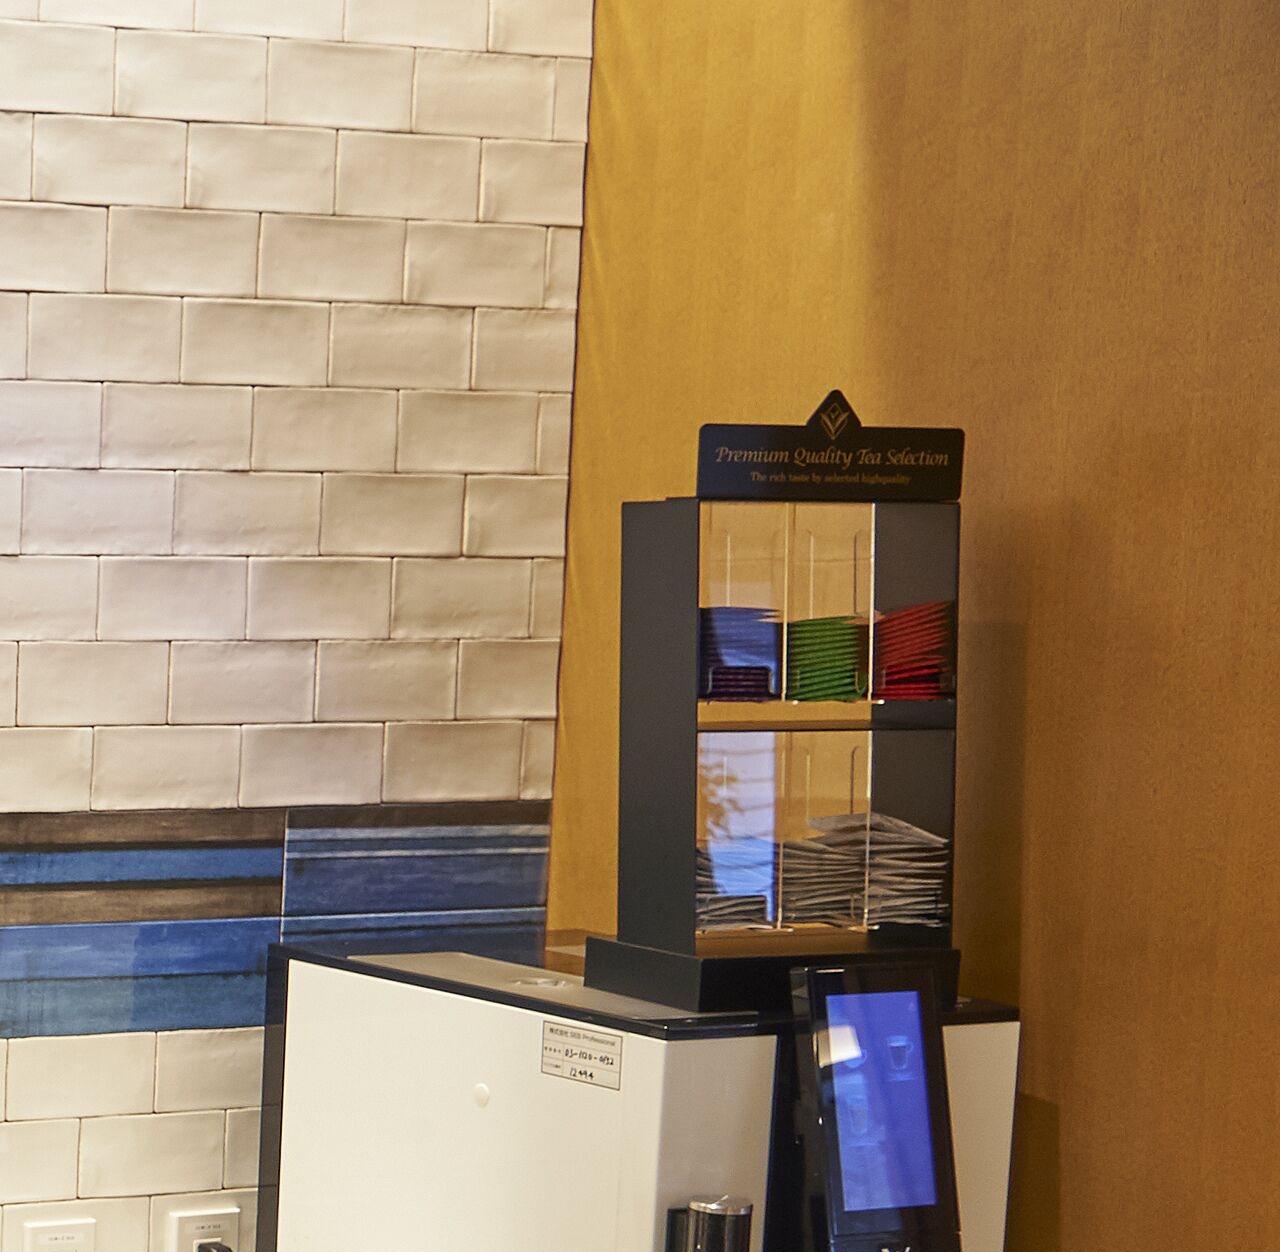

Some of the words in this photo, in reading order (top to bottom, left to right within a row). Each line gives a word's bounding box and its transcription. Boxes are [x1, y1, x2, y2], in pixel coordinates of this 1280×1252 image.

[715, 446, 789, 463] Premium
[793, 446, 853, 470] Quality
[856, 448, 881, 465] Tea
[886, 447, 949, 466] Selection
[751, 472, 767, 481] The
[769, 472, 787, 481] rich
[811, 472, 821, 484] by
